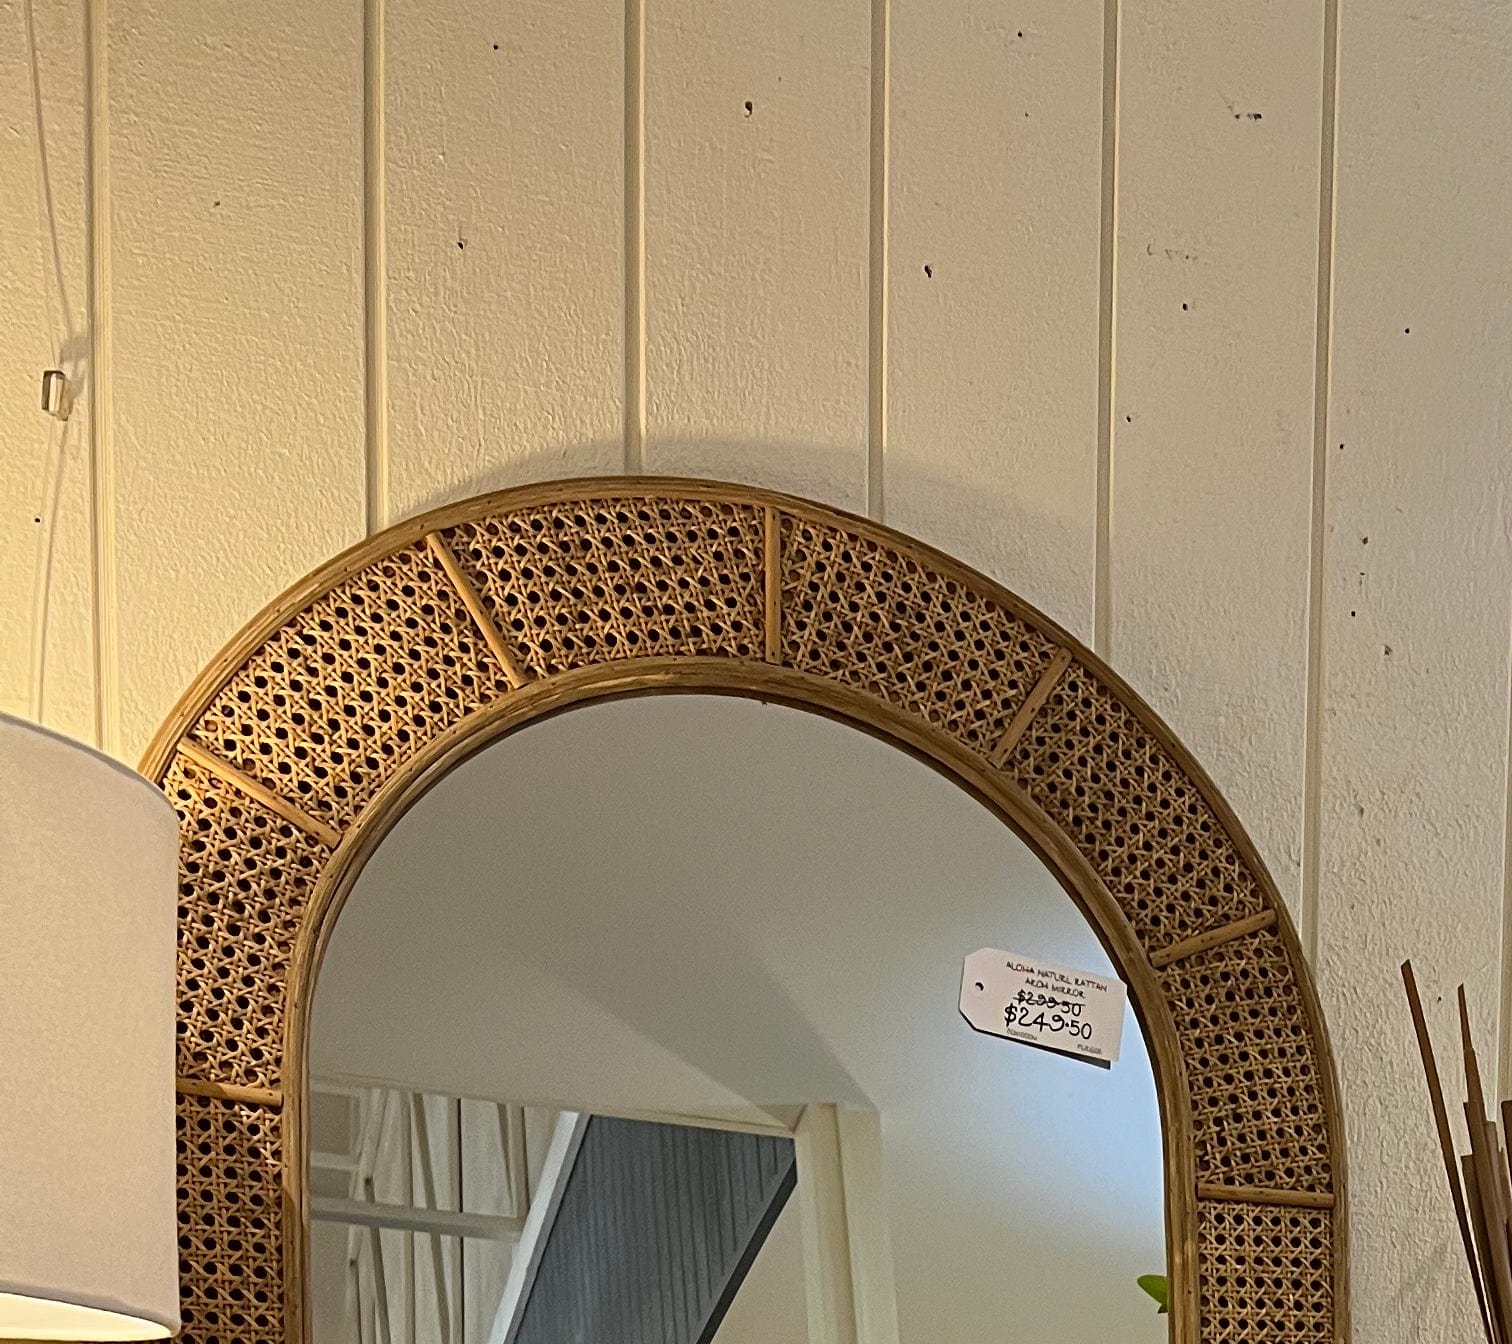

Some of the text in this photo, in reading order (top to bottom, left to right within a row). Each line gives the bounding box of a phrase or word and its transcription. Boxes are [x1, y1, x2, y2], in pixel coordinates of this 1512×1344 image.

[1051, 984, 1085, 998] MIRROR
[1074, 978, 1107, 992] RATTAN
[1004, 1003, 1092, 1039] $249.50
